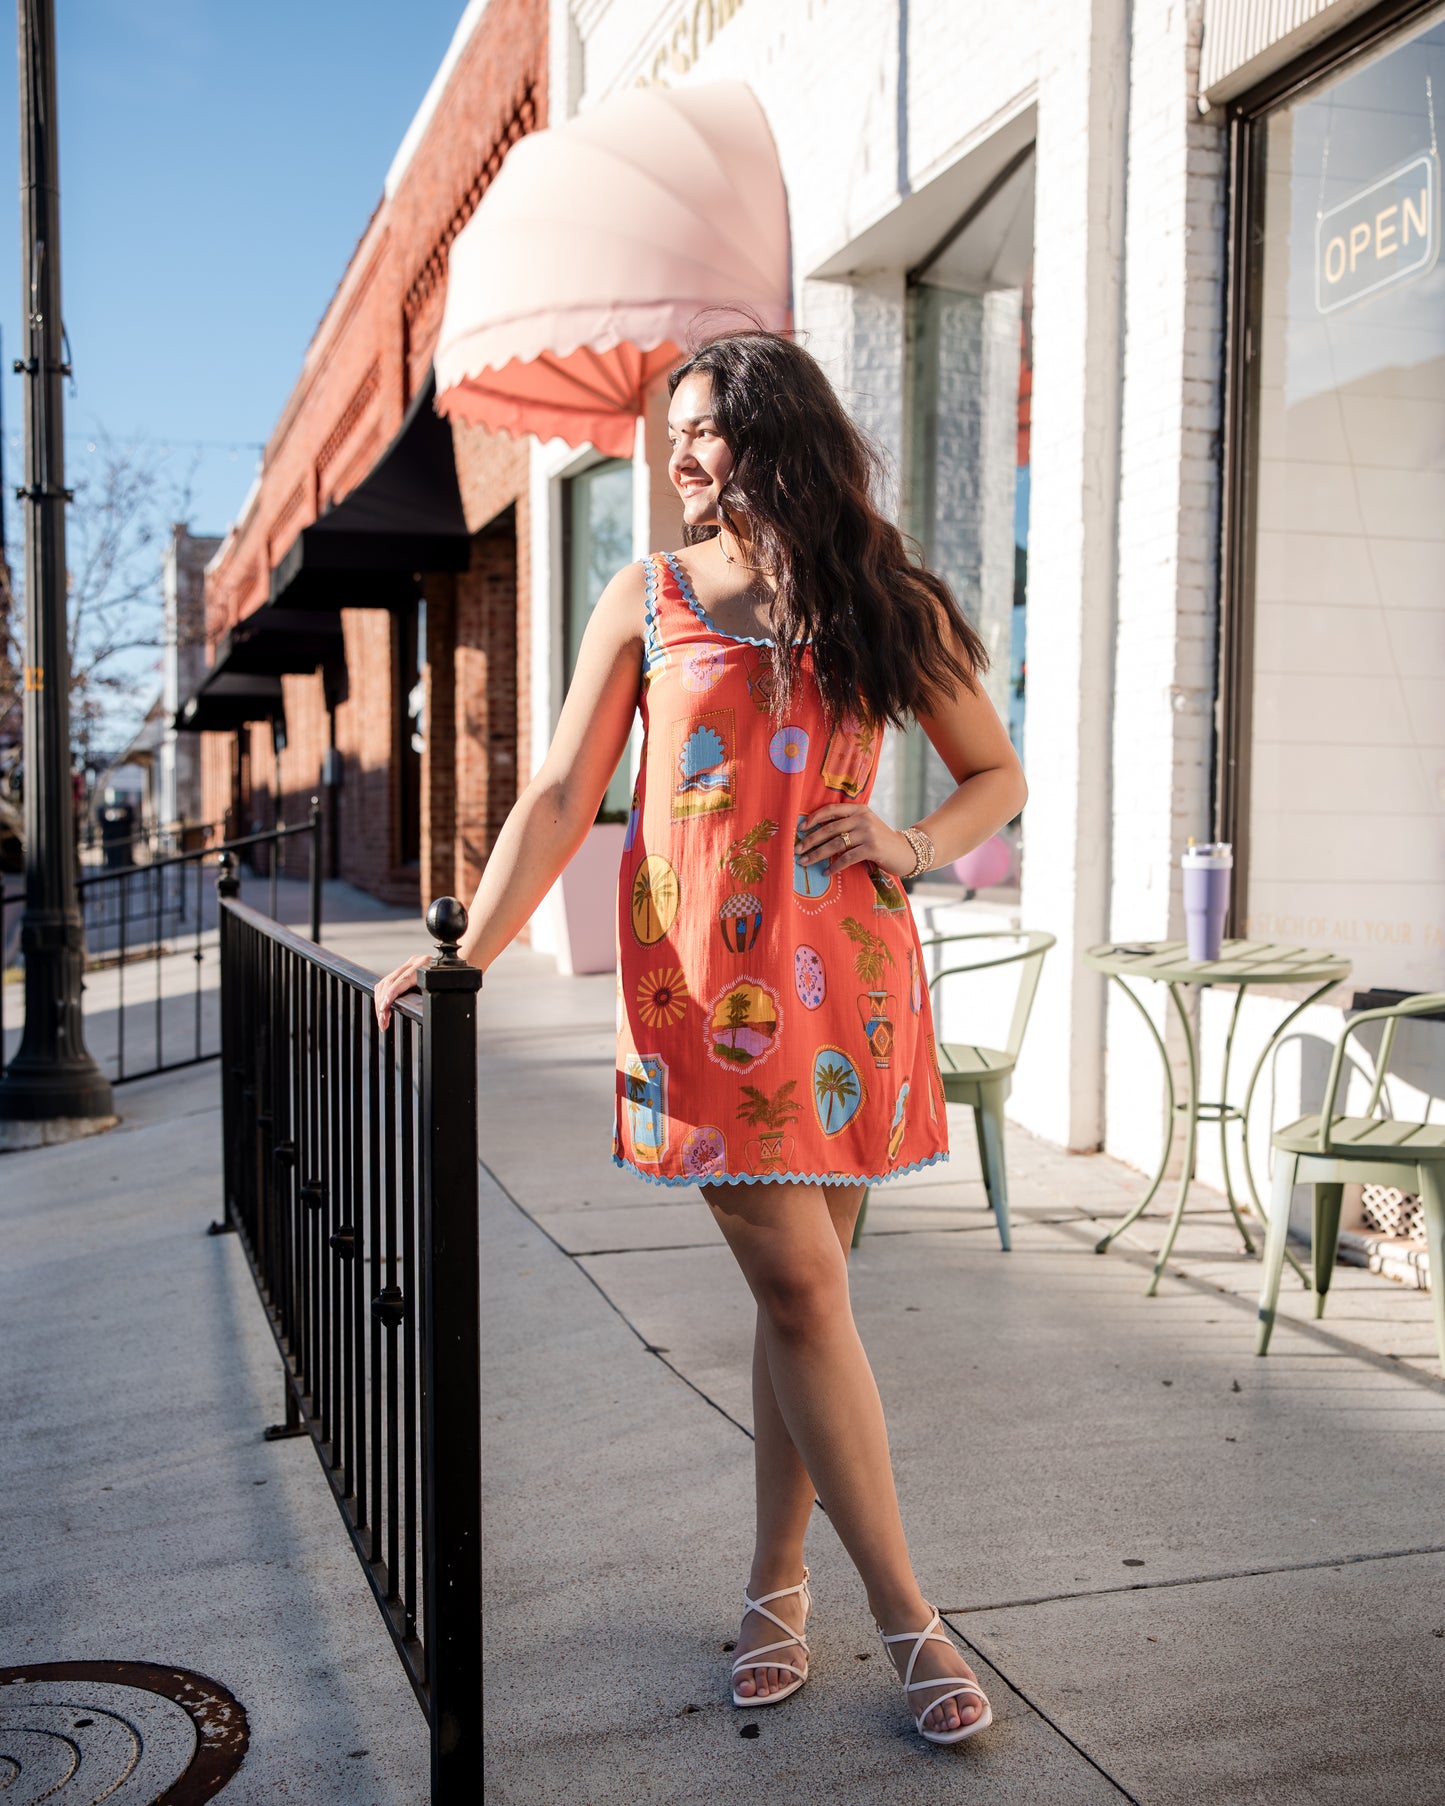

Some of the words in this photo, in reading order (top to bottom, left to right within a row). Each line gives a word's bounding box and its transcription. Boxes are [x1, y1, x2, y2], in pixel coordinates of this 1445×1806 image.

[1325, 188, 1427, 284] OPEN
[1333, 918, 1361, 942] ALL
[1364, 919, 1412, 945] YOUR
